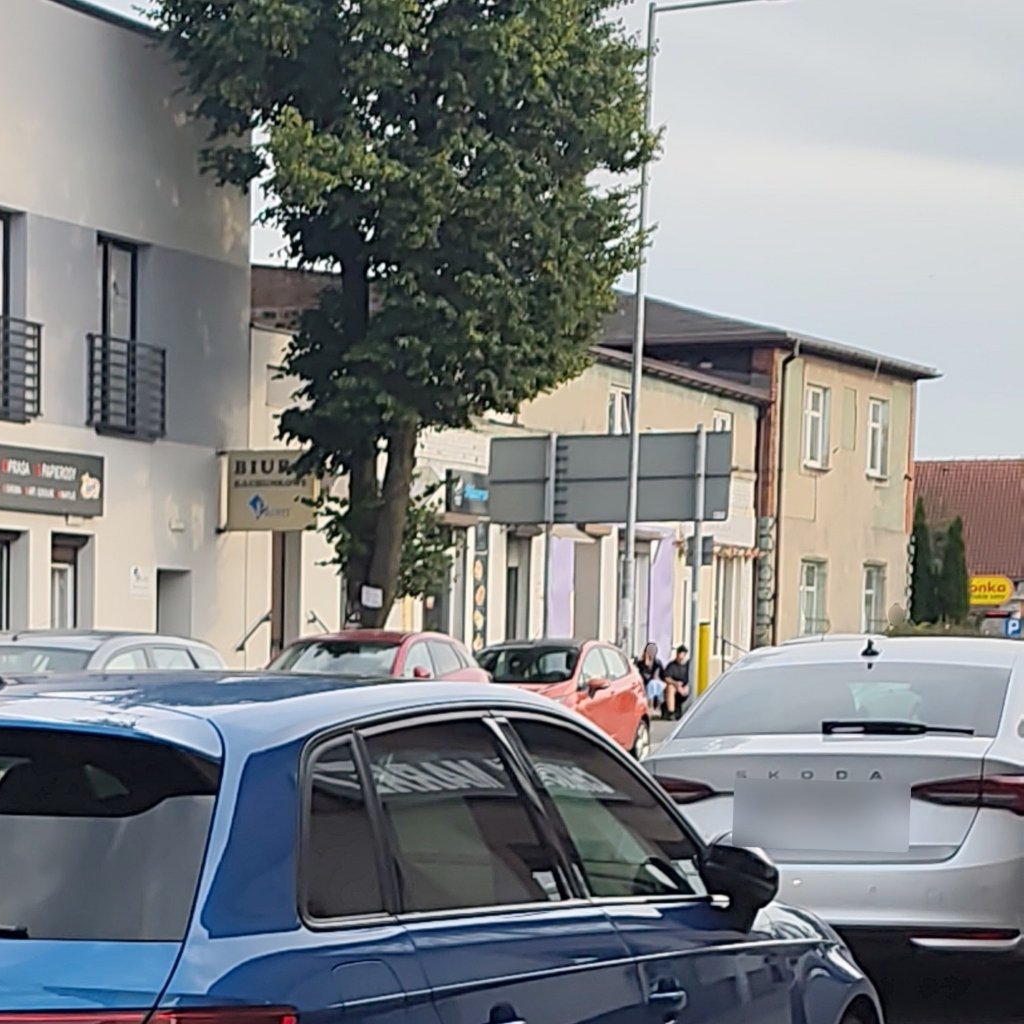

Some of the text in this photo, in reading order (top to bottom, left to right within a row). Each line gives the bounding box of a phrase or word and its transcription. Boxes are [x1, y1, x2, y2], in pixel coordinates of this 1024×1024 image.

[234, 458, 292, 475] BIUR
[970, 581, 1006, 593] onka
[736, 769, 882, 781] SKODA
